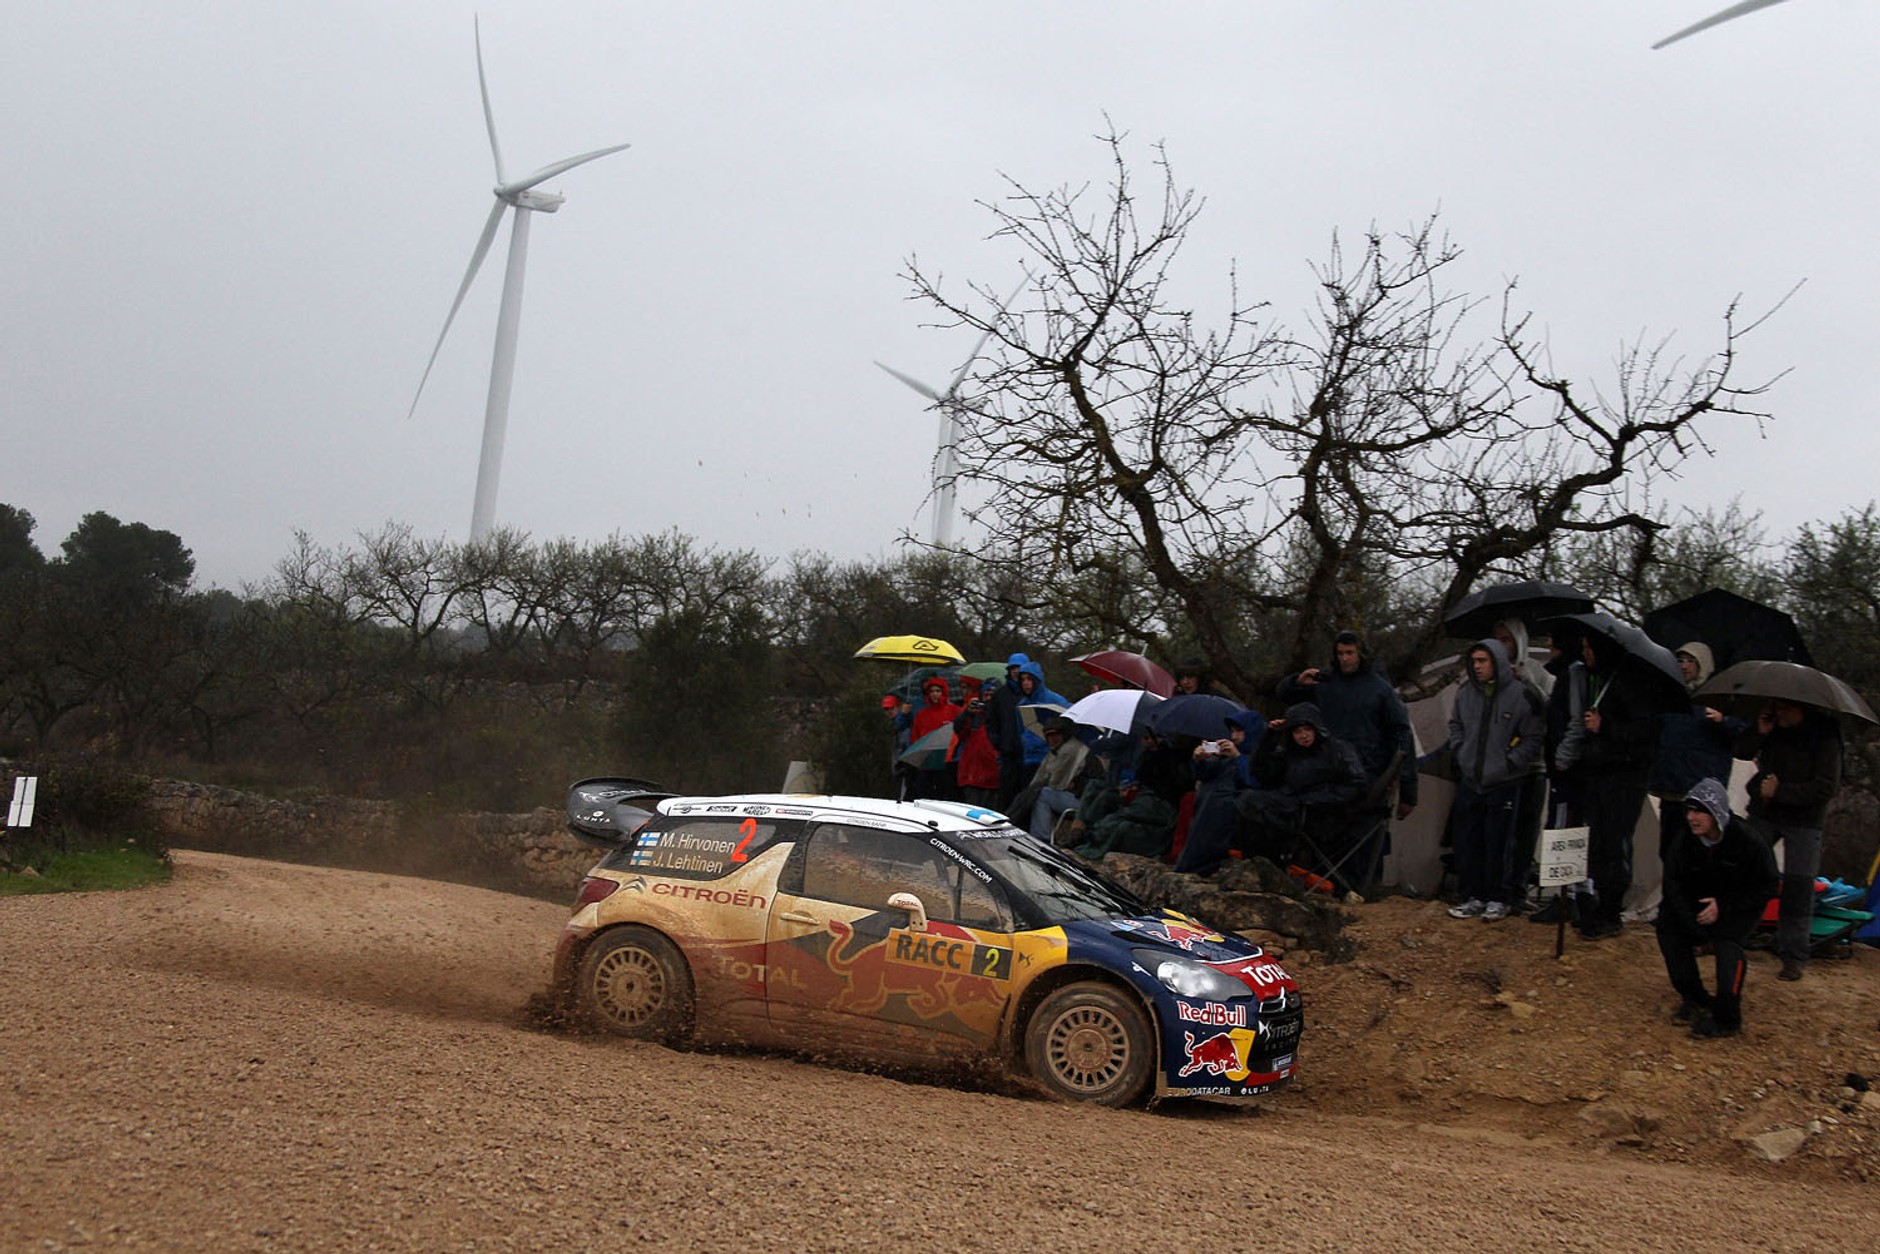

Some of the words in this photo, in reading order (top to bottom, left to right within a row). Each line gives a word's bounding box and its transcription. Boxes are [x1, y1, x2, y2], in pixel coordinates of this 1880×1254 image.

[576, 814, 611, 823] LUNTA
[660, 832, 675, 848] M.
[678, 833, 736, 853] Hirvonen
[731, 818, 757, 863] 2
[653, 852, 664, 868] J.
[666, 852, 723, 874] Lehtinen
[897, 899, 918, 907] TOTAL
[896, 933, 964, 970] RACC
[983, 948, 1000, 977] 2
[721, 955, 808, 989] TOTAL
